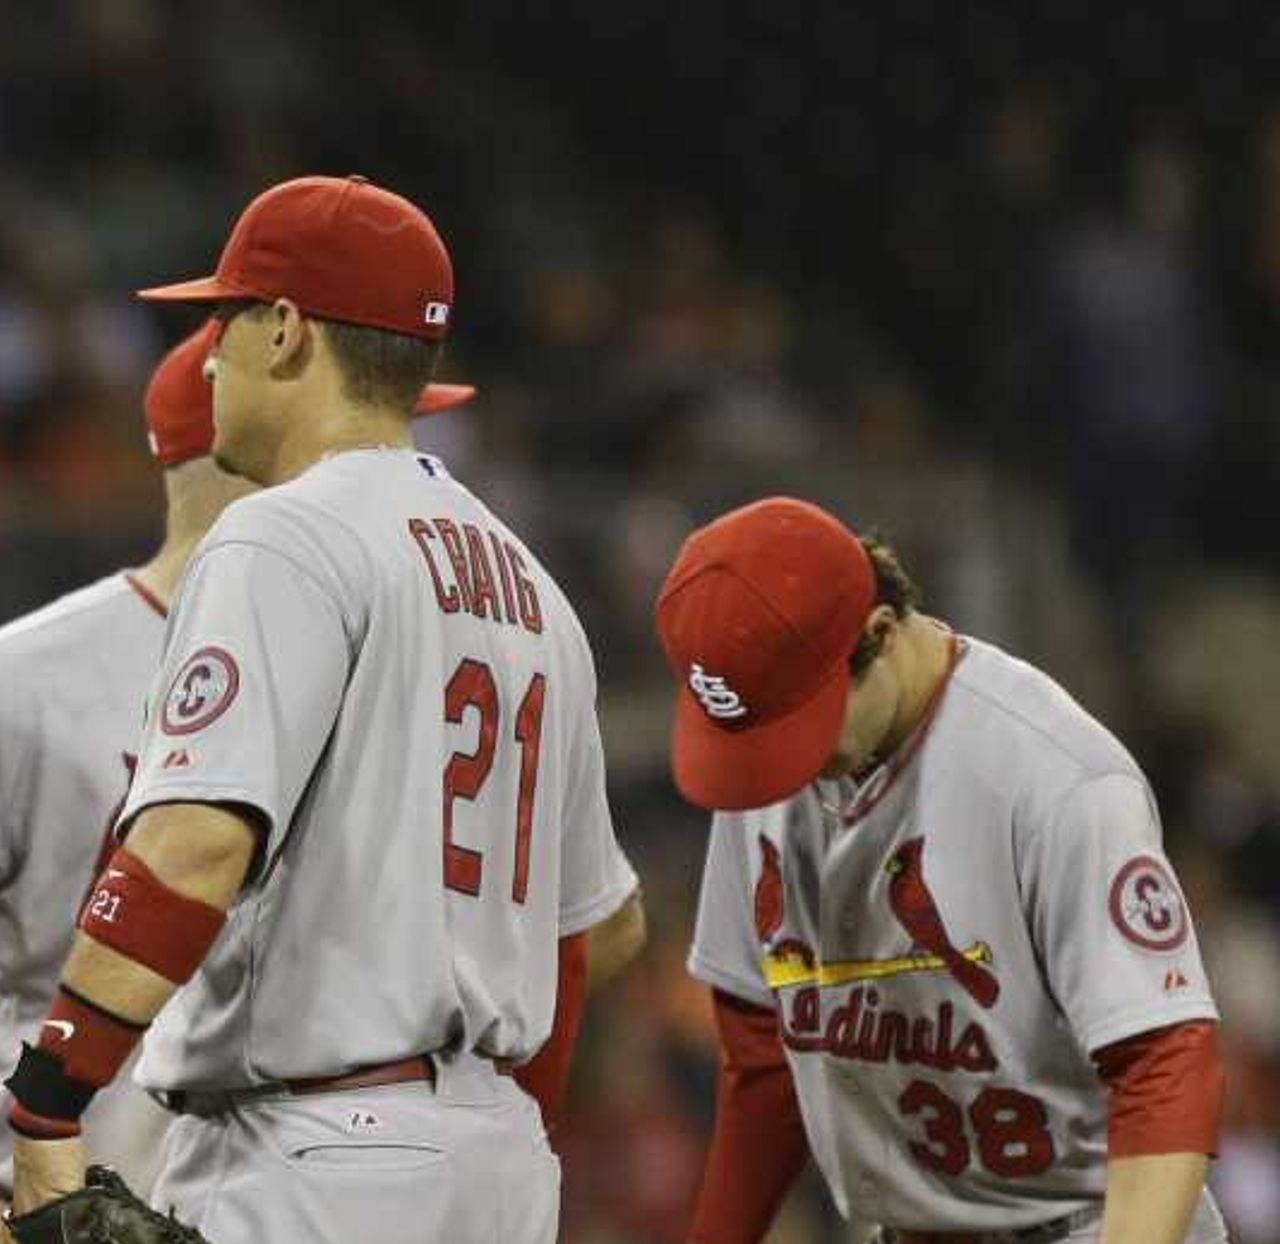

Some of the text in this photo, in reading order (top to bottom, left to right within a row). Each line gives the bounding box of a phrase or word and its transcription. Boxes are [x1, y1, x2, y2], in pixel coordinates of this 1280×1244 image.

[408, 518, 542, 634] CRAIG
[443, 657, 546, 904] 21
[91, 889, 120, 921] 21
[898, 1080, 1056, 1178] 38
